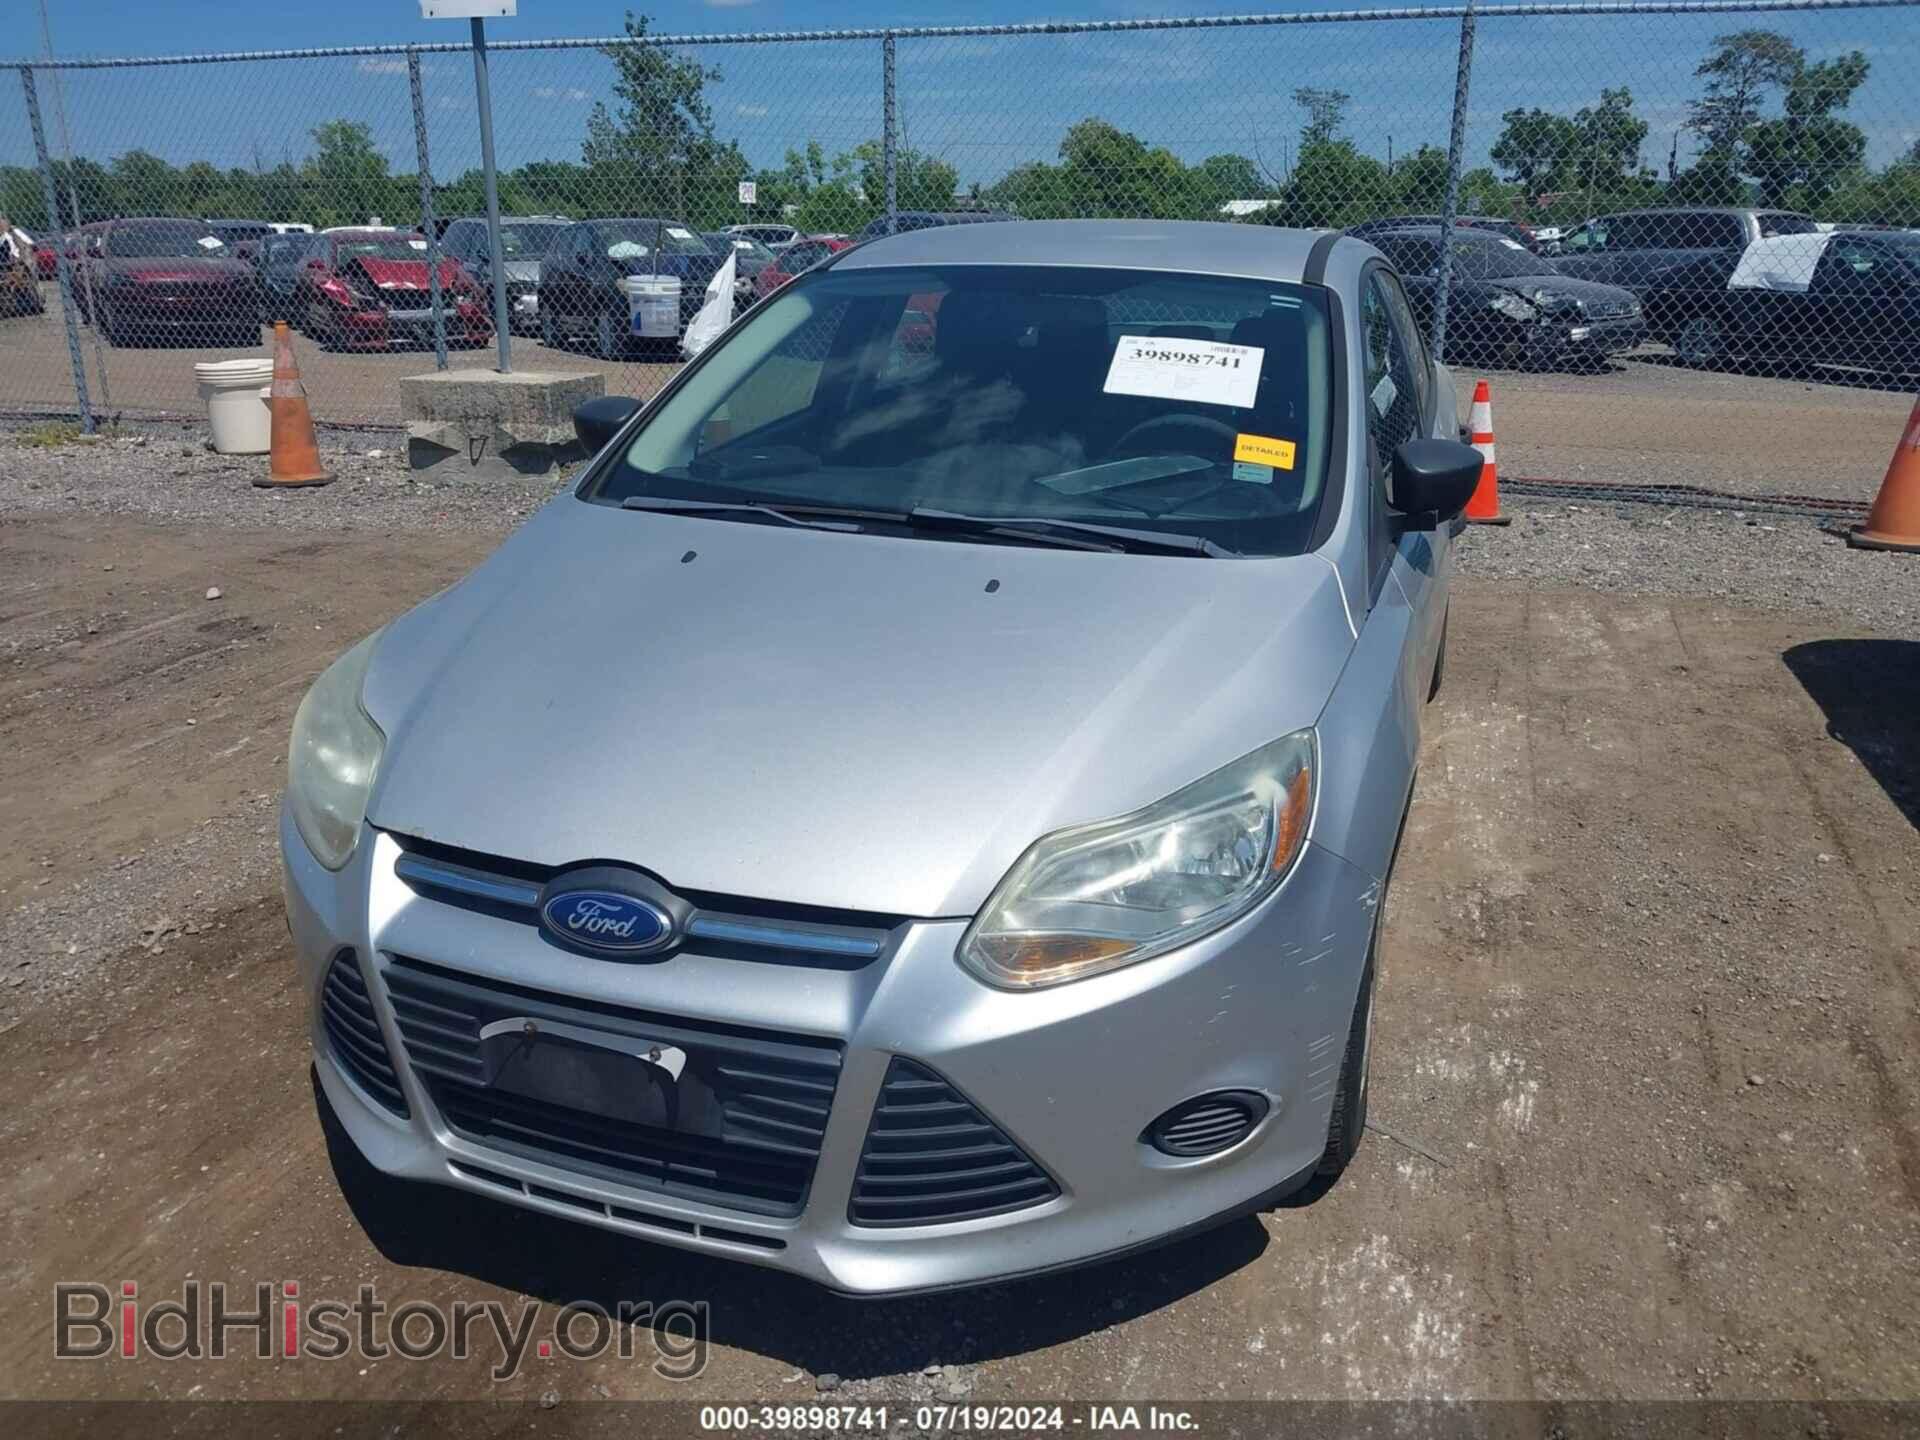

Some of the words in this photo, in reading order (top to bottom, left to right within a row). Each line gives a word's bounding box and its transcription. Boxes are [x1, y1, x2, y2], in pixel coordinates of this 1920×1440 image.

[1129, 347, 1241, 369] 39898741
[1241, 444, 1289, 458] DETAILED
[567, 899, 638, 938] Ford
